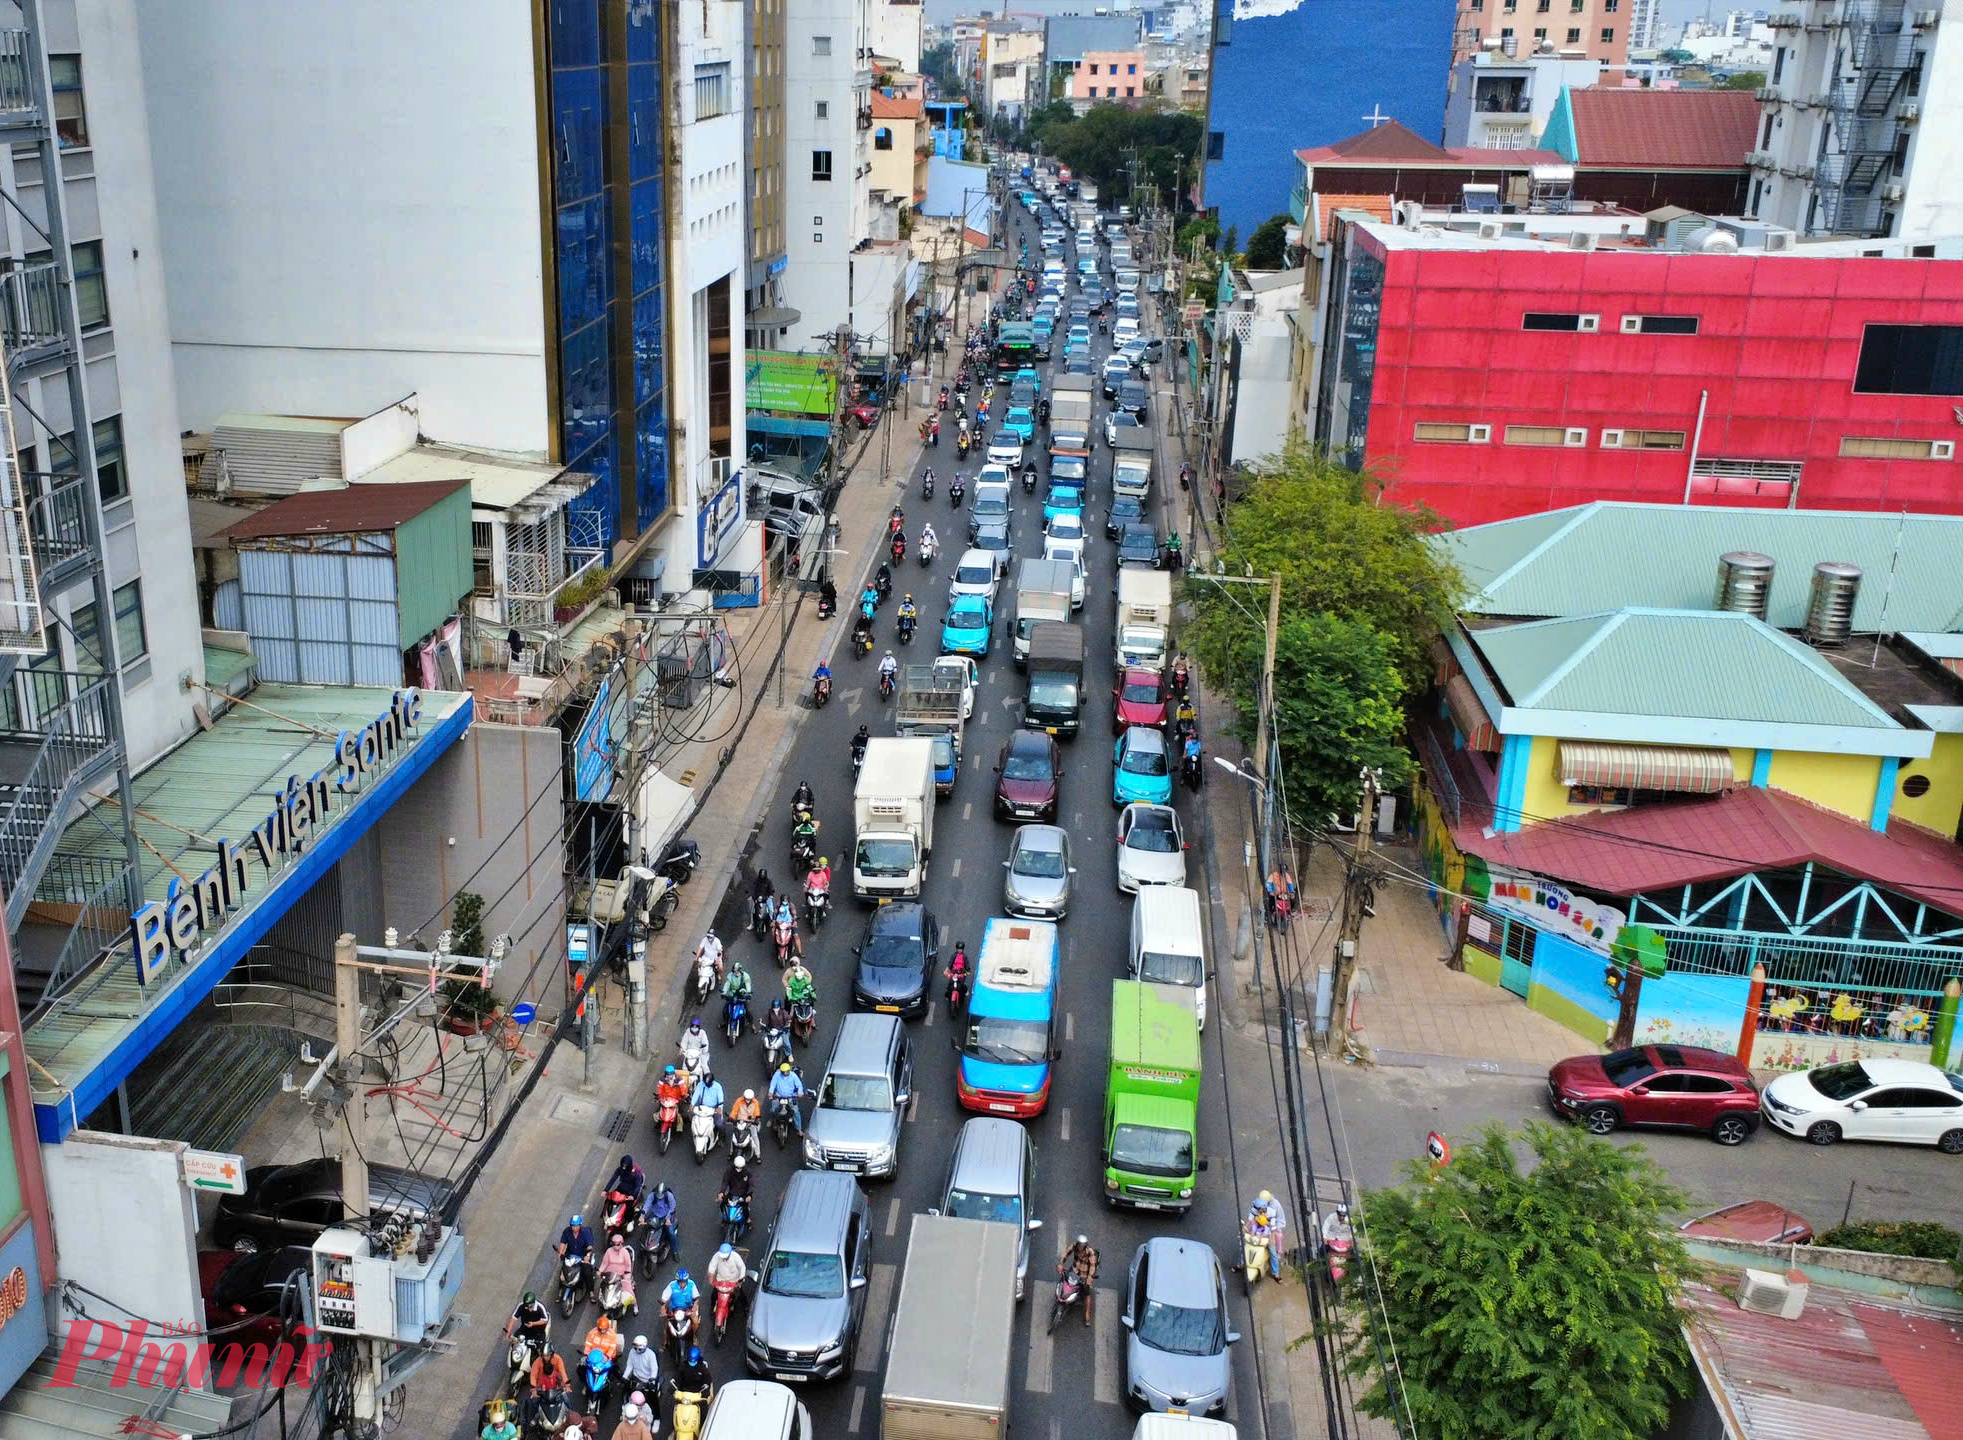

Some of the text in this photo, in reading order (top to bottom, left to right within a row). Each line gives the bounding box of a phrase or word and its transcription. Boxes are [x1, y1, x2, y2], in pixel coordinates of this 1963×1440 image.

[130, 685, 424, 986] Bệnh viện Sante
